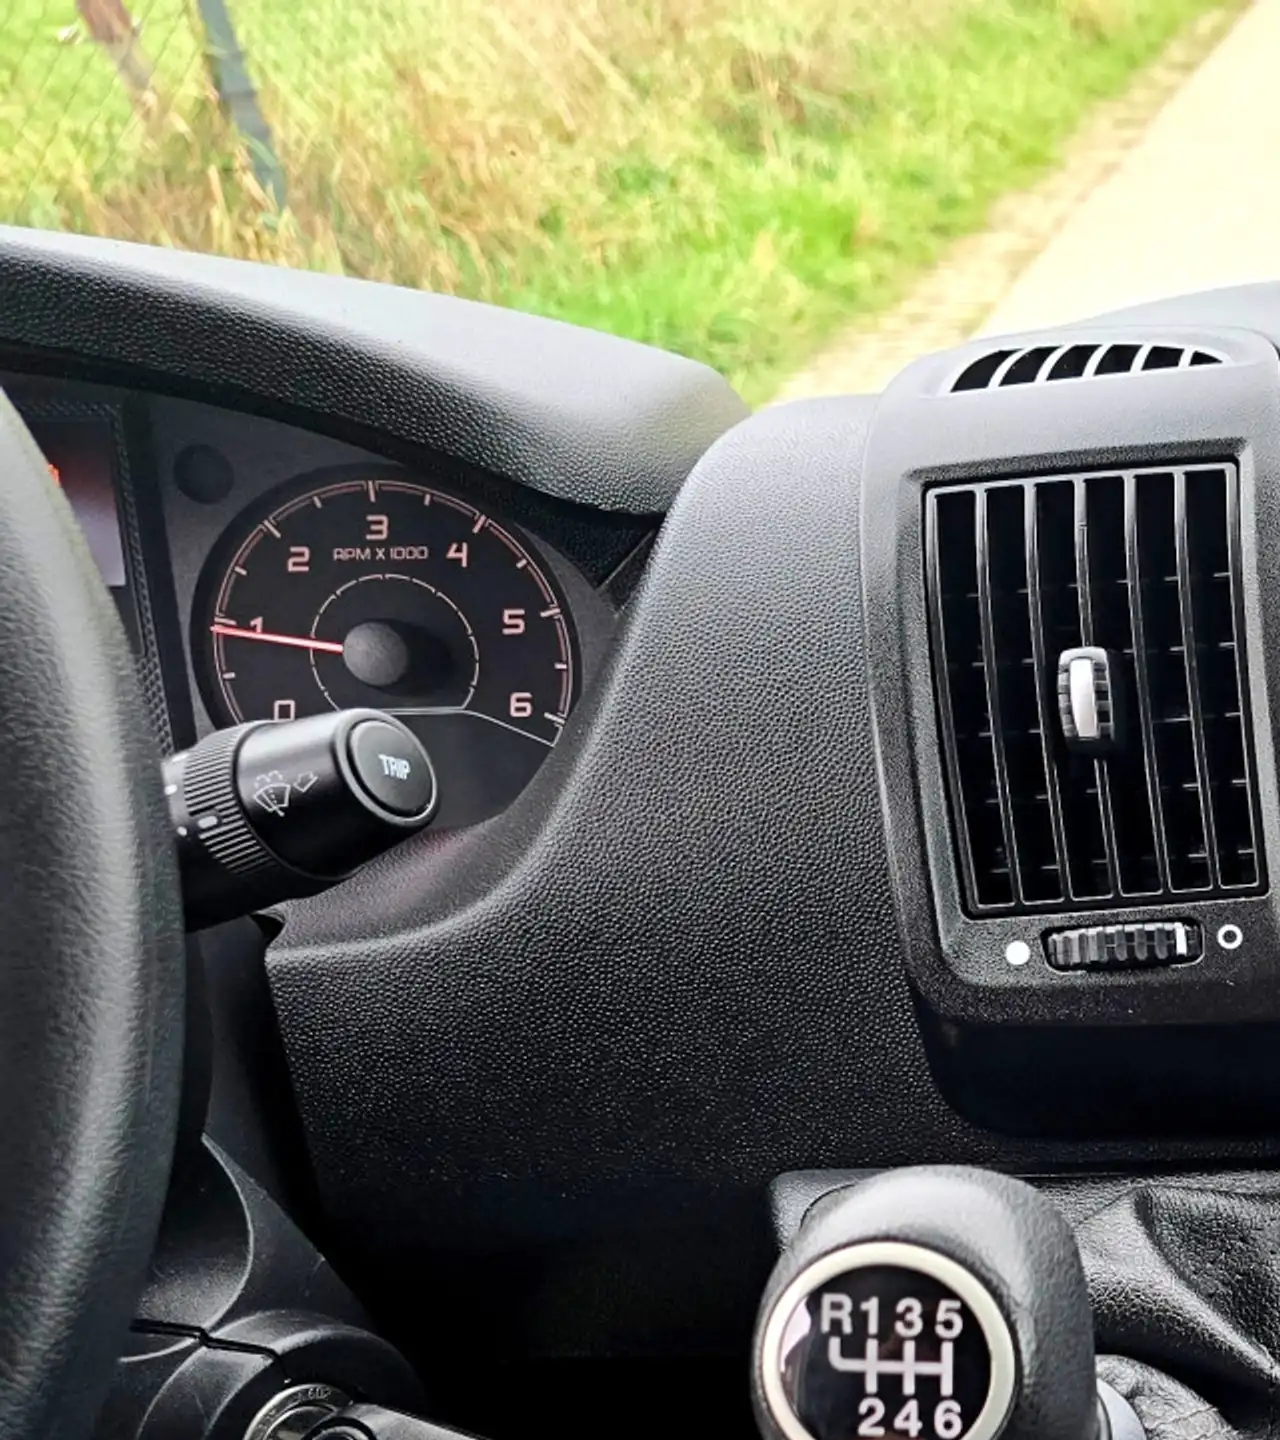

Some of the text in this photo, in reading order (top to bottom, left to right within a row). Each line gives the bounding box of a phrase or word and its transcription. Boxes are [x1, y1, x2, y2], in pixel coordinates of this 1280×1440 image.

[365, 514, 390, 541] 3
[287, 546, 310, 572] 2
[333, 546, 428, 561] RPM X 1000
[446, 543, 470, 568] 4
[502, 608, 526, 636] 5
[509, 692, 533, 718] 6
[378, 753, 412, 781] TRIP
